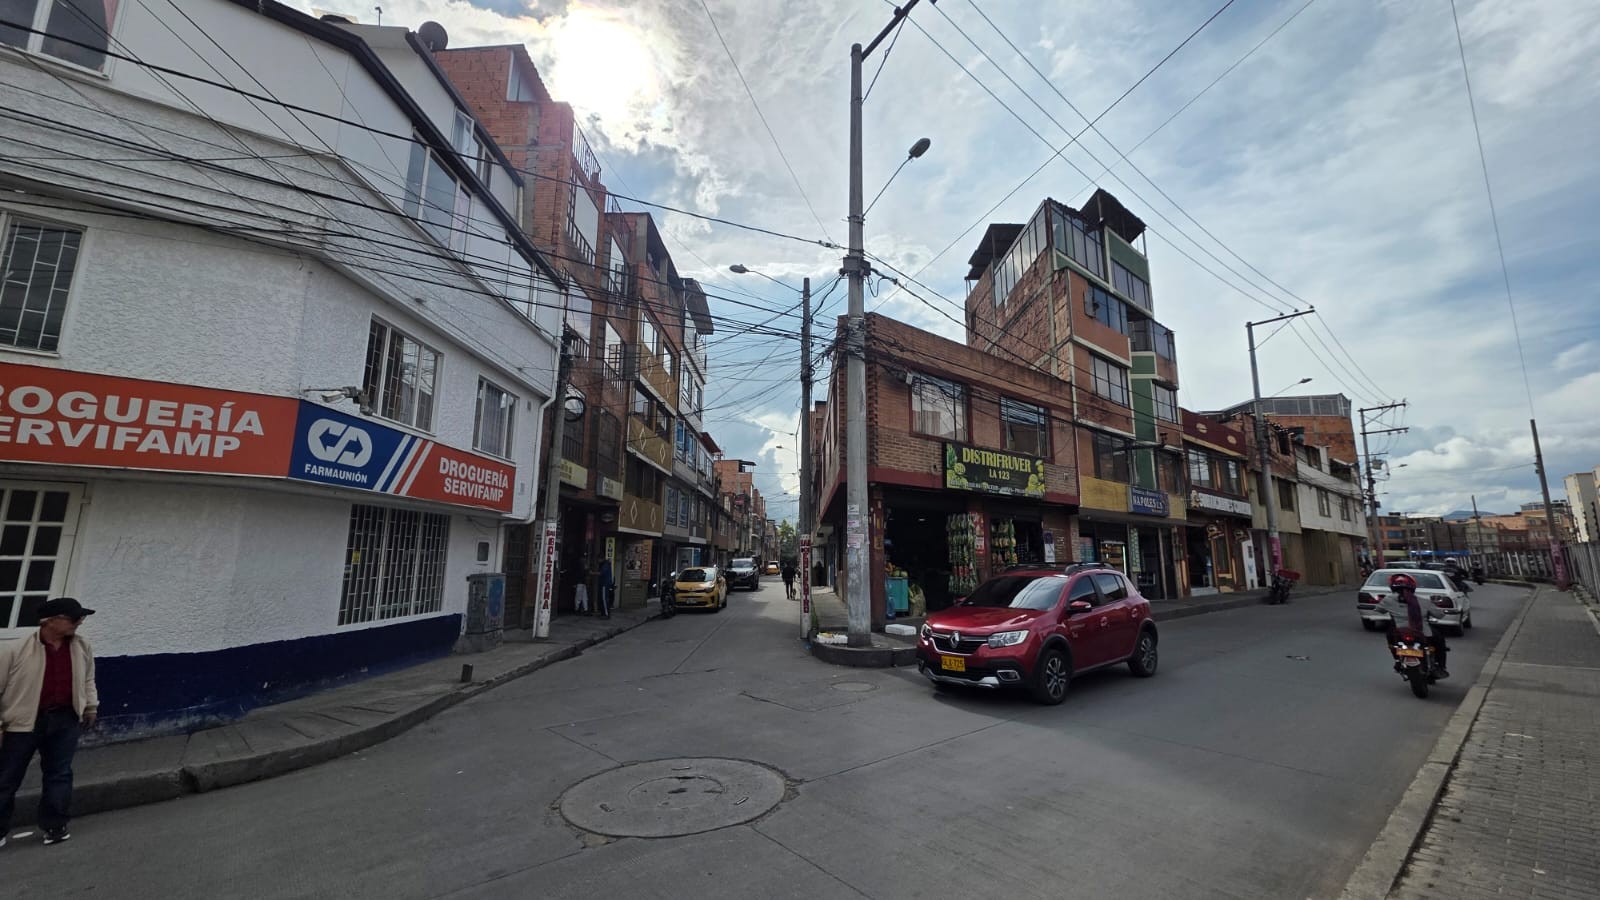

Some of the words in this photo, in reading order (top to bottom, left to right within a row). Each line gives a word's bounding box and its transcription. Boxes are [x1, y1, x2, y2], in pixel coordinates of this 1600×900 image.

[0, 385, 265, 436] OGUERÍA
[962, 447, 1032, 473] DISTRIFRUVER
[304, 463, 368, 484] FARMAUNIÓN
[439, 457, 509, 489] DROGUERÍA
[989, 469, 998, 479] LA
[998, 470, 1010, 480] 123
[443, 477, 504, 502] SERVIFAMP
